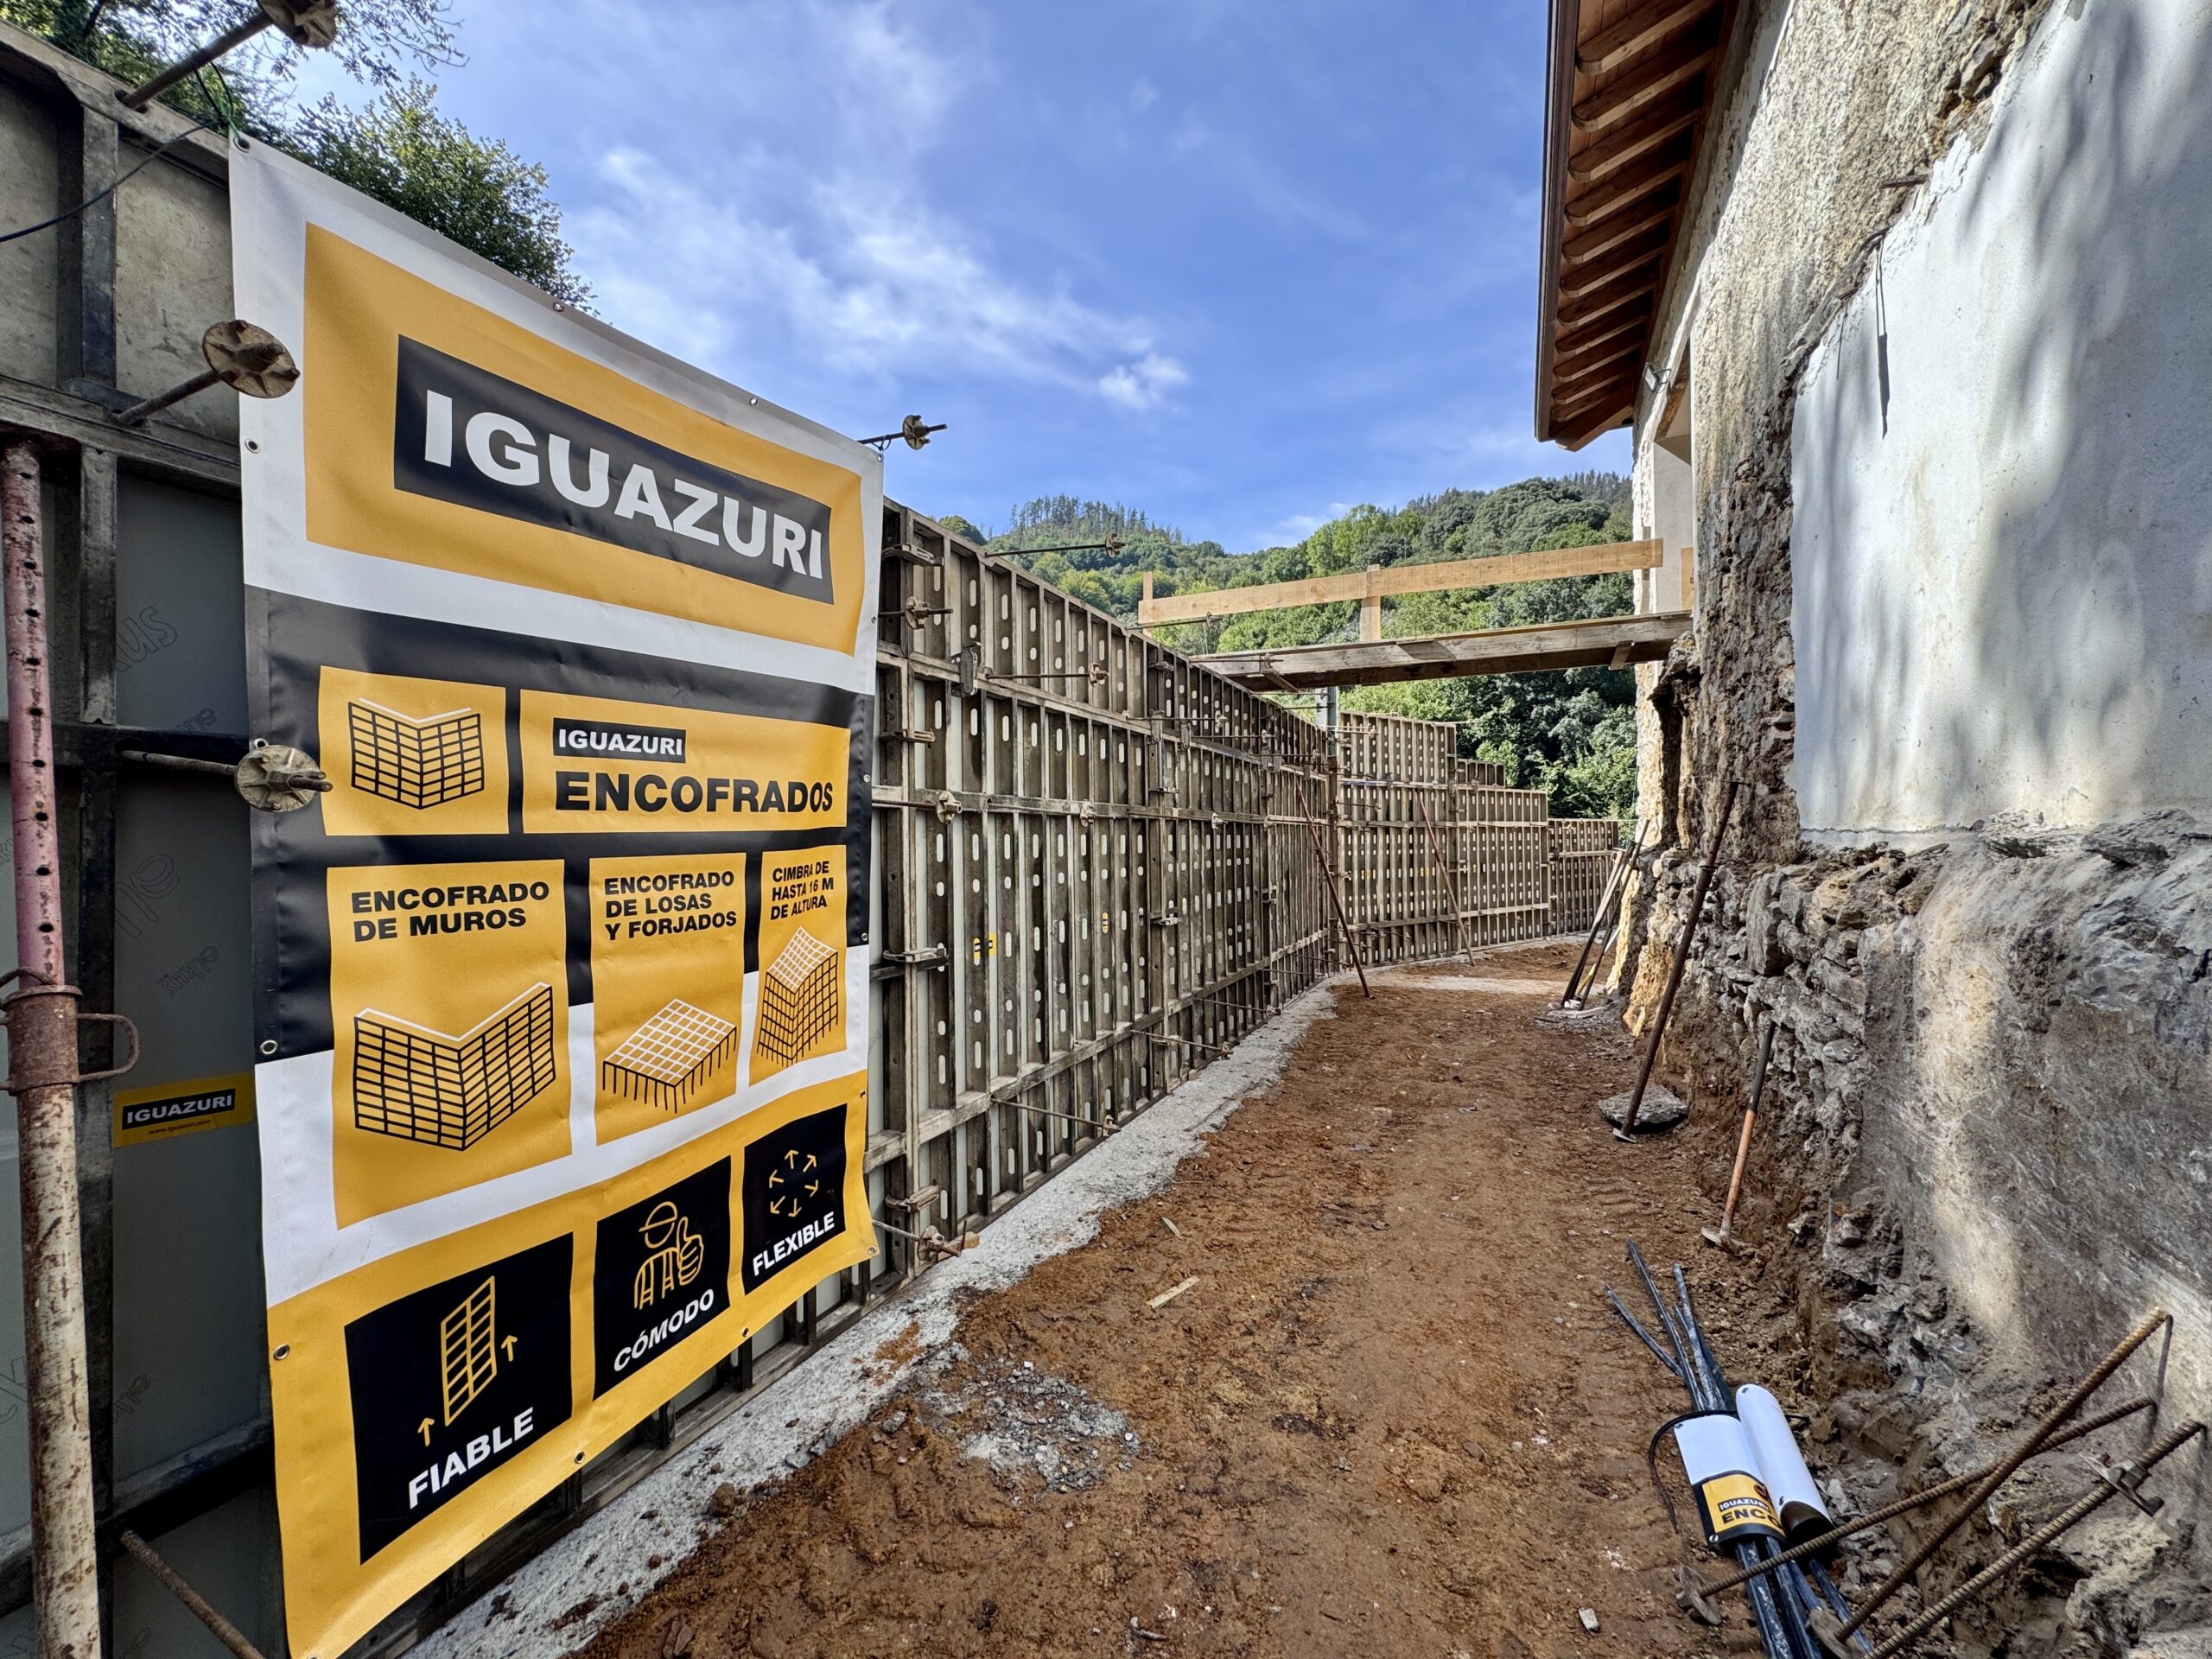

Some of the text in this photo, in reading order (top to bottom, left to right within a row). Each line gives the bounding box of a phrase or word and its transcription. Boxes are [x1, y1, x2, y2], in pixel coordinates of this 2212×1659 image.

[424, 389, 823, 580] IGUAZURI
[558, 728, 683, 756] IGUAZURI
[555, 770, 834, 813] ENCOFRADOS
[604, 870, 734, 895] ENCOFRADO
[772, 861, 830, 882] CIMBRA DE
[351, 881, 550, 913] ENCOFRADO
[772, 877, 834, 901] HASTA 16 M
[605, 893, 713, 918] DE LOSAS
[770, 894, 828, 920] DE ALTURA
[353, 907, 527, 943] DE MUROS
[605, 911, 737, 941] Y FORJADOS
[126, 1094, 232, 1124] IGUAZURI
[752, 1211, 836, 1277] FLEXIBLE
[613, 1288, 715, 1372] CÓMODO
[408, 1407, 534, 1510] FIABLE
